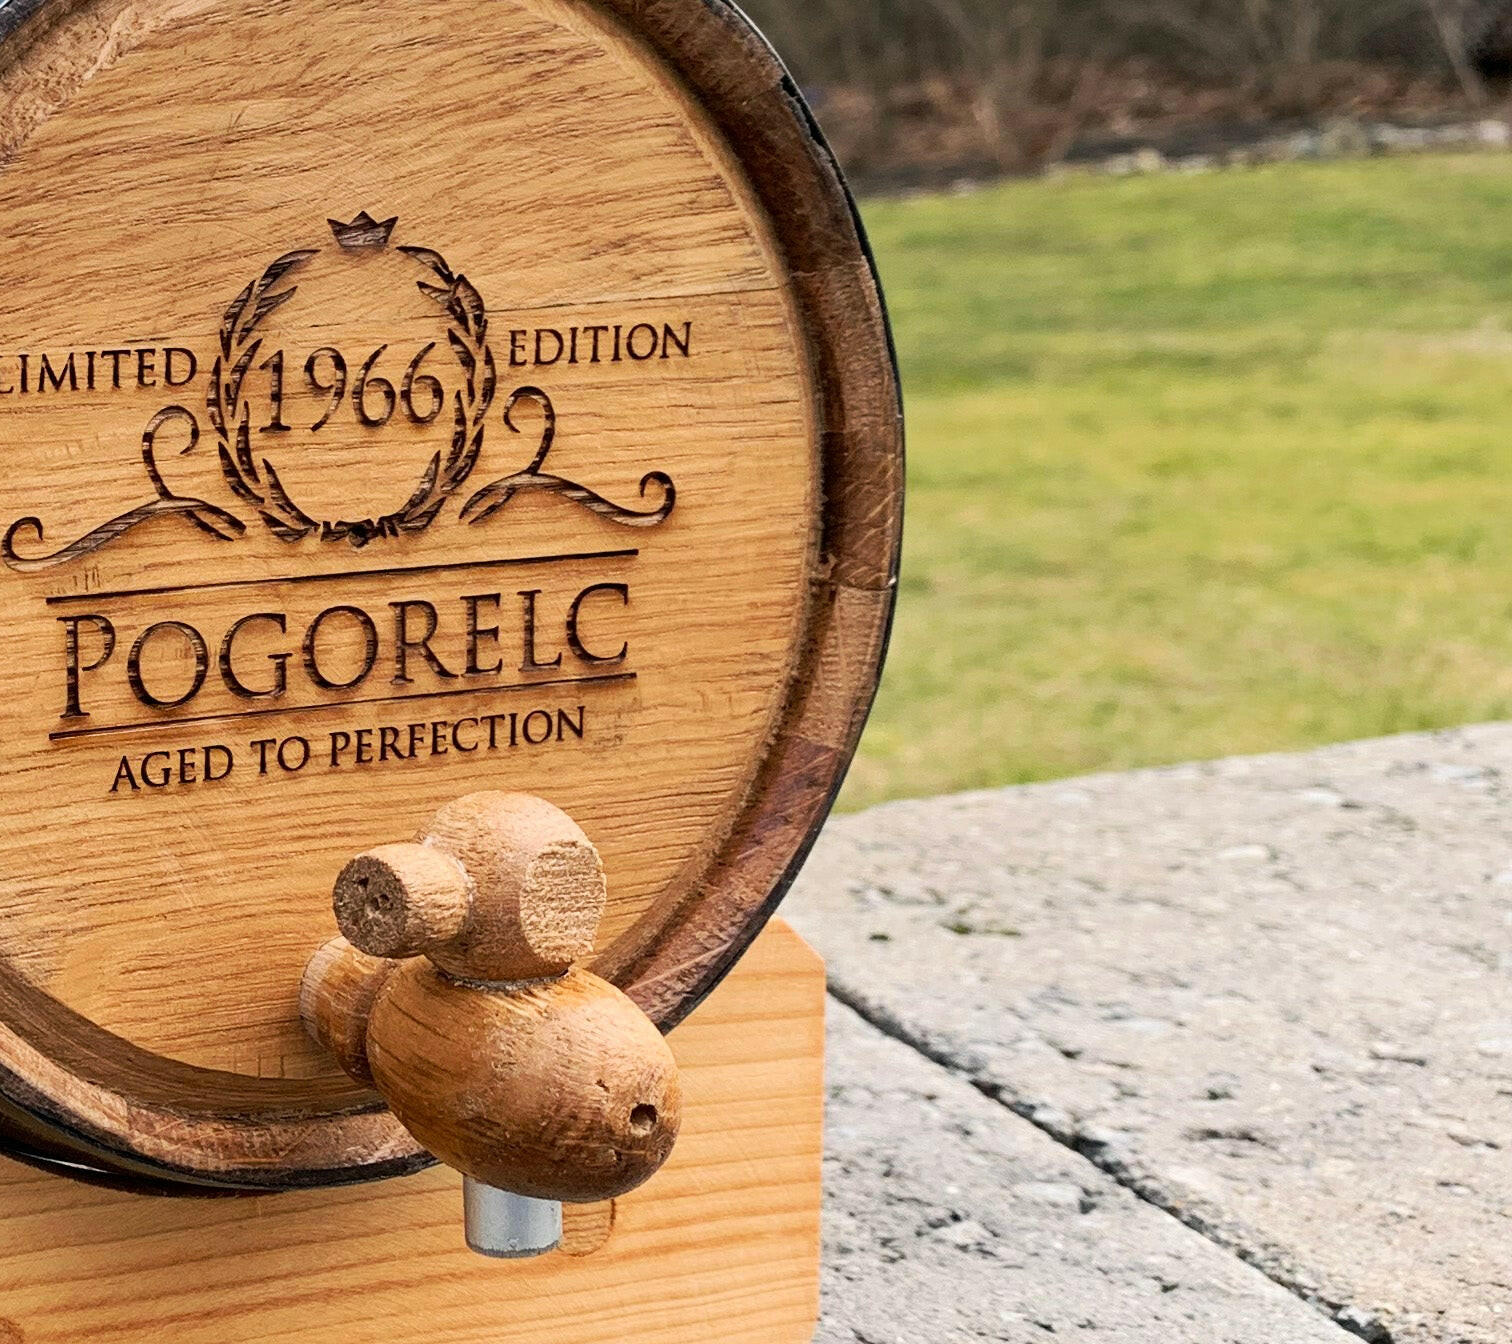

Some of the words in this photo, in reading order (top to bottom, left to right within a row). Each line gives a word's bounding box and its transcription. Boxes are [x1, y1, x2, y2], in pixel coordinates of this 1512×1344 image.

[257, 342, 445, 434] 1966
[508, 321, 694, 367] EDITION
[57, 582, 630, 720] POGORELC
[110, 742, 234, 793] AGED
[250, 735, 310, 774] TO
[328, 705, 587, 768] PERFECTION
